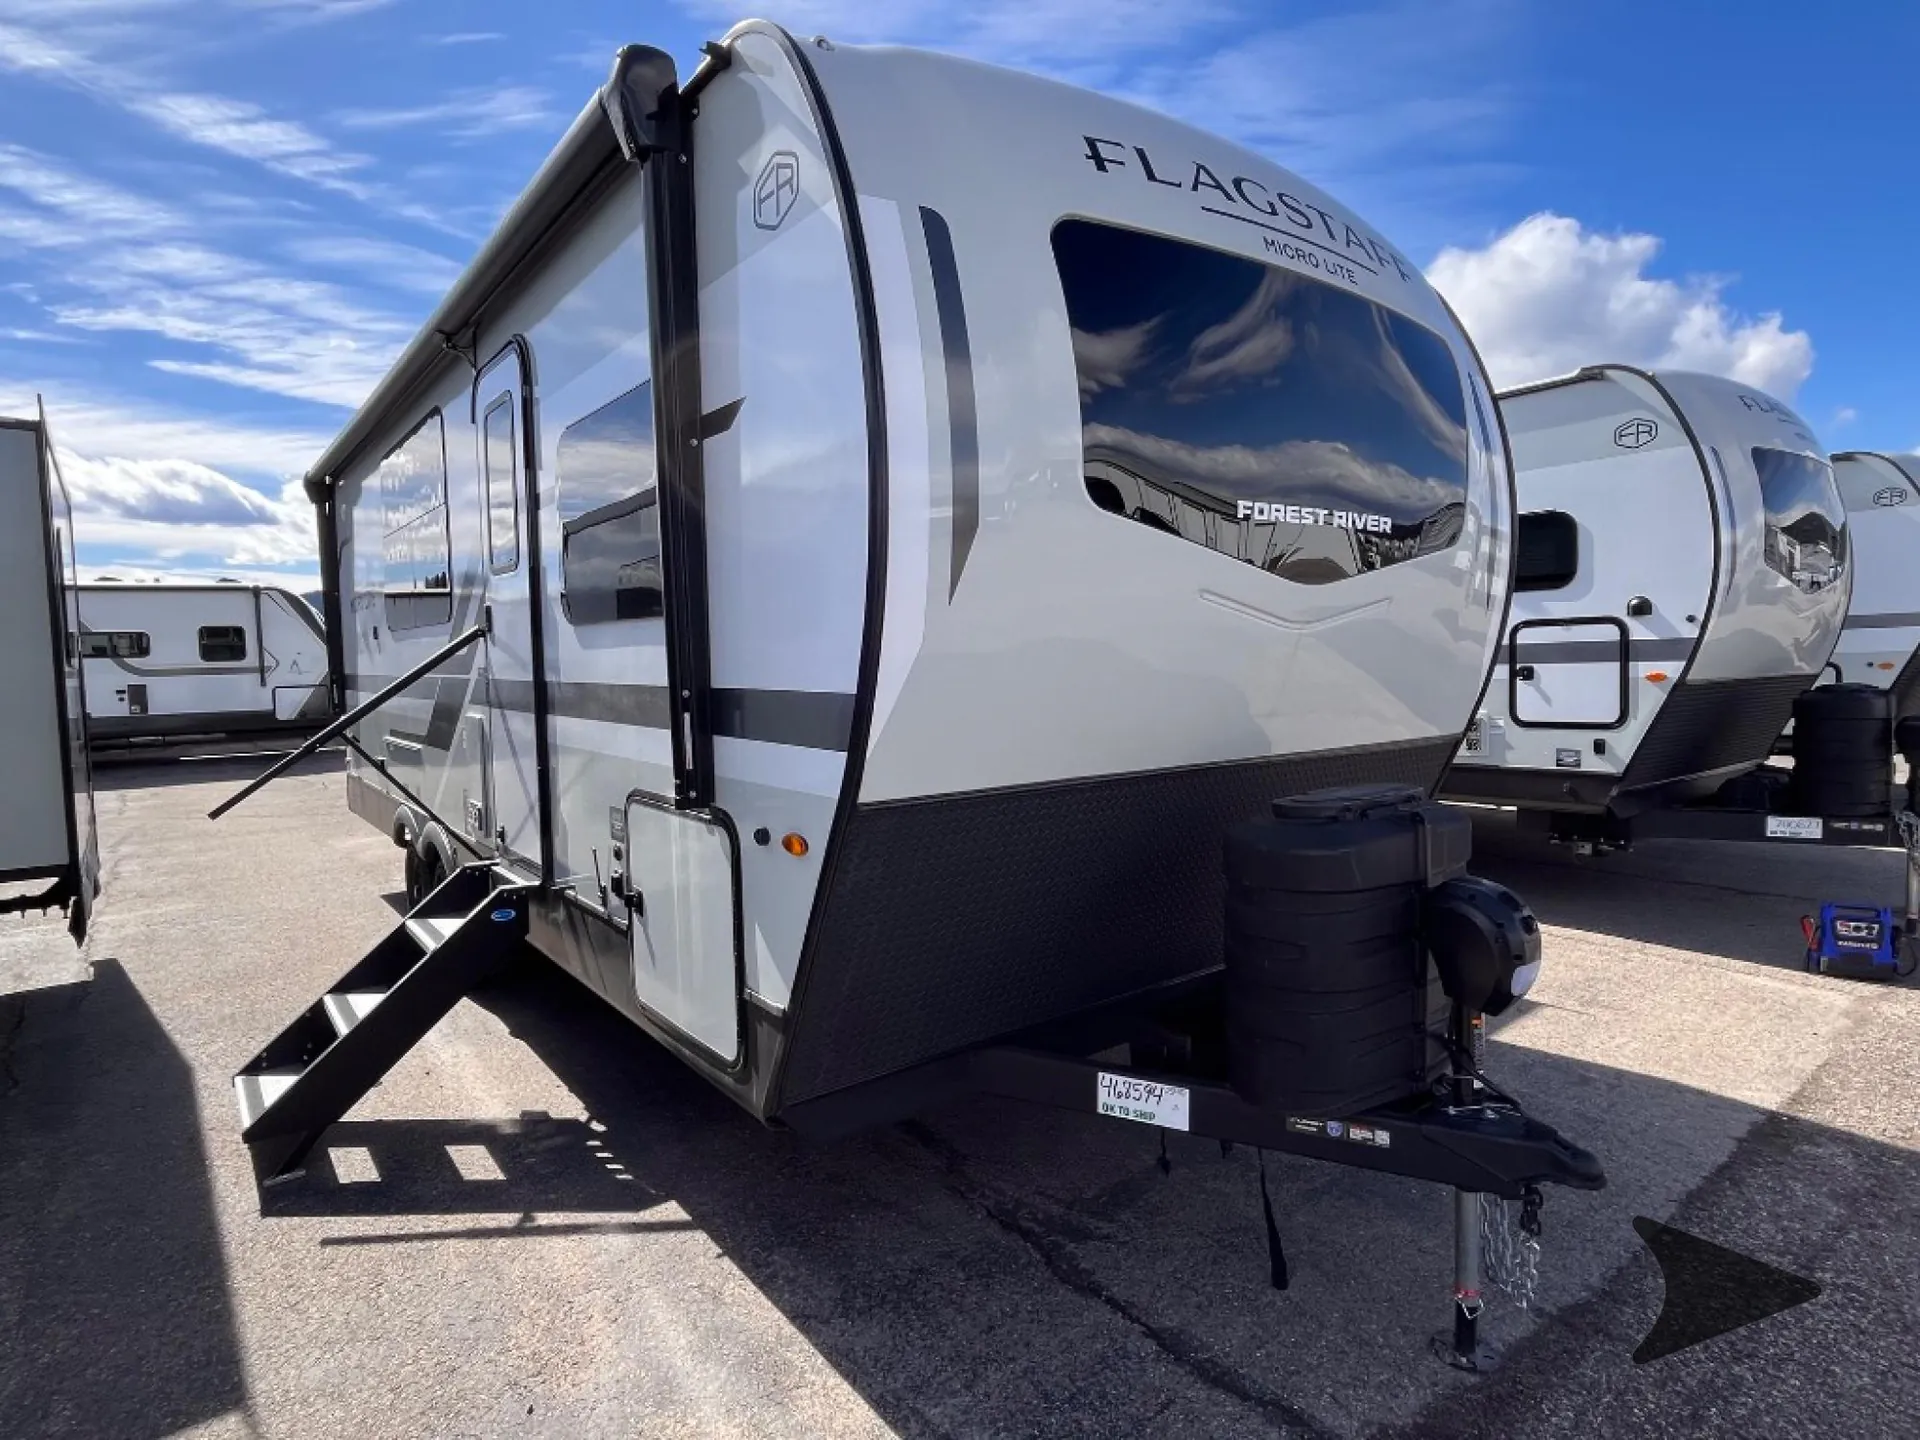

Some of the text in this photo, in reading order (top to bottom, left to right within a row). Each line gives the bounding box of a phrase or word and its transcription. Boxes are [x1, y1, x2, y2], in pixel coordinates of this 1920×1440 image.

[1082, 135, 1411, 283] FLAGSTAFF
[1263, 236, 1358, 286] MICRO LITE
[1236, 500, 1393, 534] FOREST RIVER
[1102, 1102, 1156, 1121] OK TO SHIP
